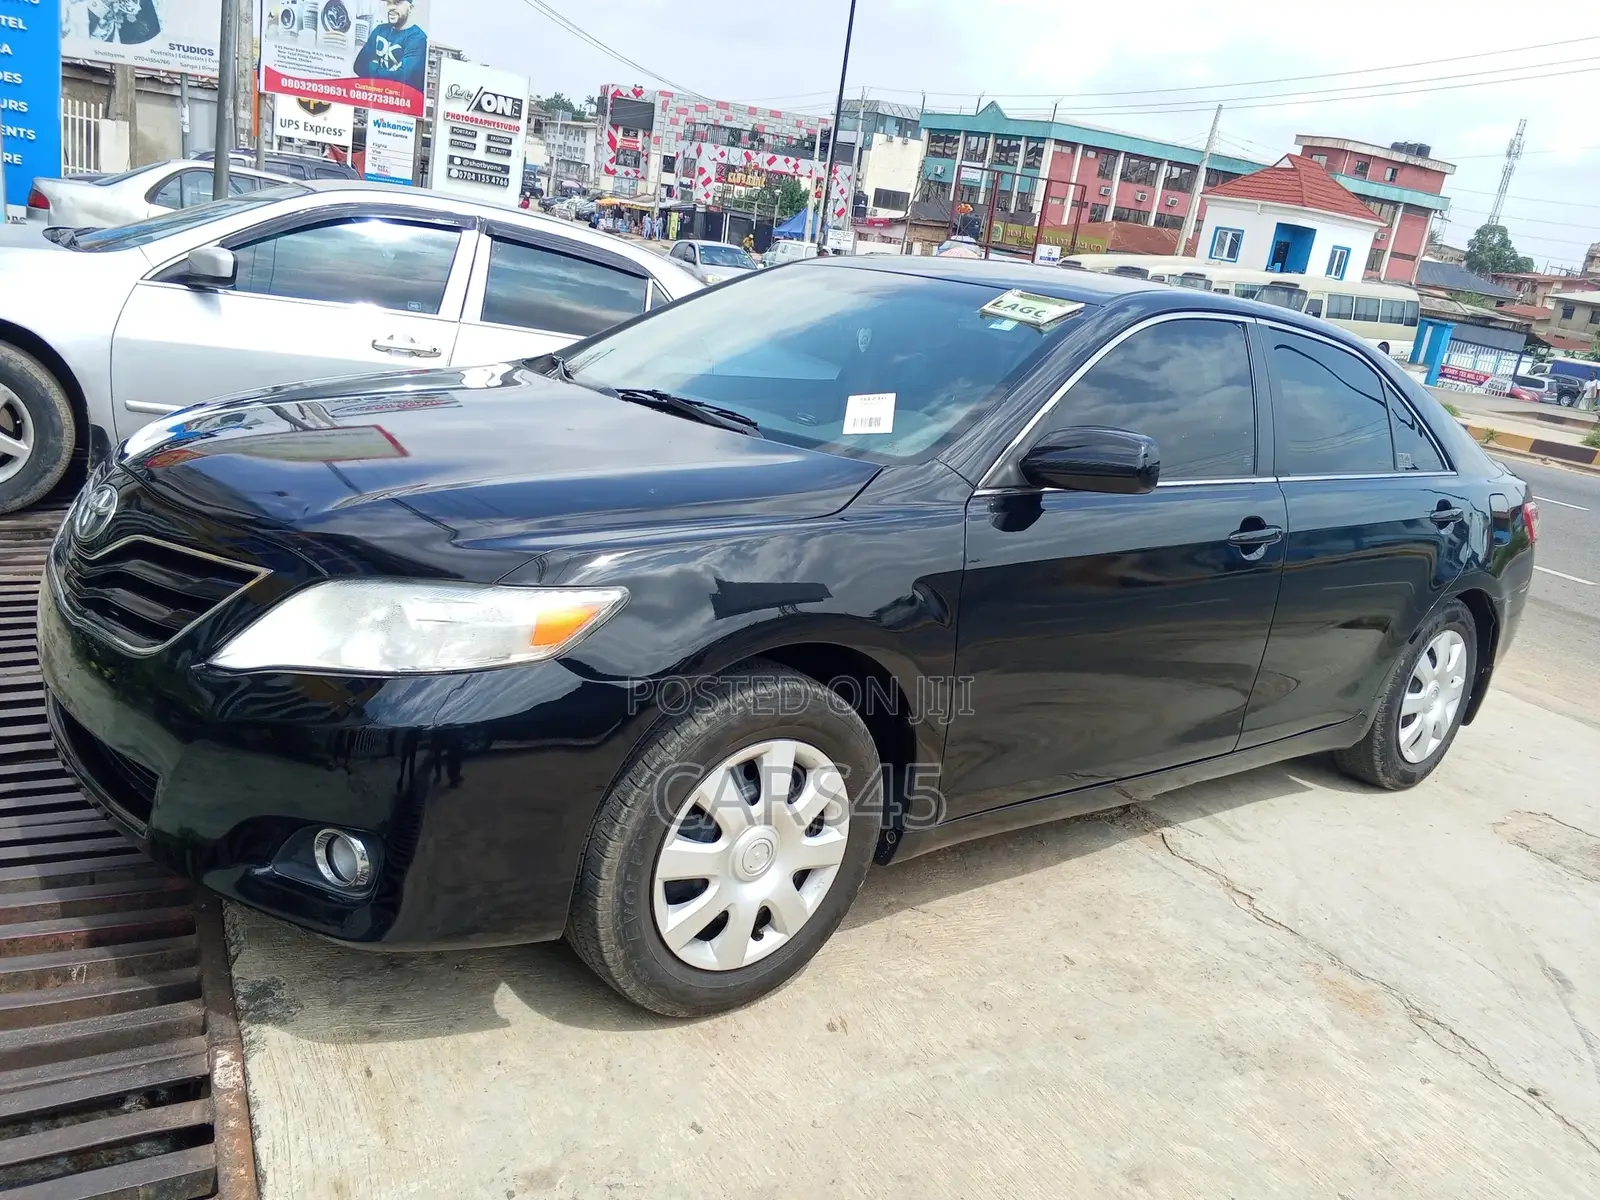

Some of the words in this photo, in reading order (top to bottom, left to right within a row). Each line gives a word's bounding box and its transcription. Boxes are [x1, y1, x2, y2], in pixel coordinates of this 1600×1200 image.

[168, 42, 214, 56] STUDIOS
[281, 78, 348, 98] 08032039631,
[349, 90, 411, 108] 08027338404
[354, 83, 384, 93] Customer
[384, 87, 401, 96] Care:
[445, 83, 465, 100] Shot
[464, 89, 474, 101] by
[280, 118, 300, 130] UPS
[303, 122, 344, 137] Express
[373, 117, 414, 132] Wakanow
[453, 127, 476, 137] PORTRAIT
[490, 135, 510, 143] FASHION
[451, 140, 475, 149] EDITORIAL
[490, 147, 508, 155] BEAUTY
[458, 171, 476, 180] 0704
[477, 174, 490, 183] 155
[491, 176, 508, 186] 4766
